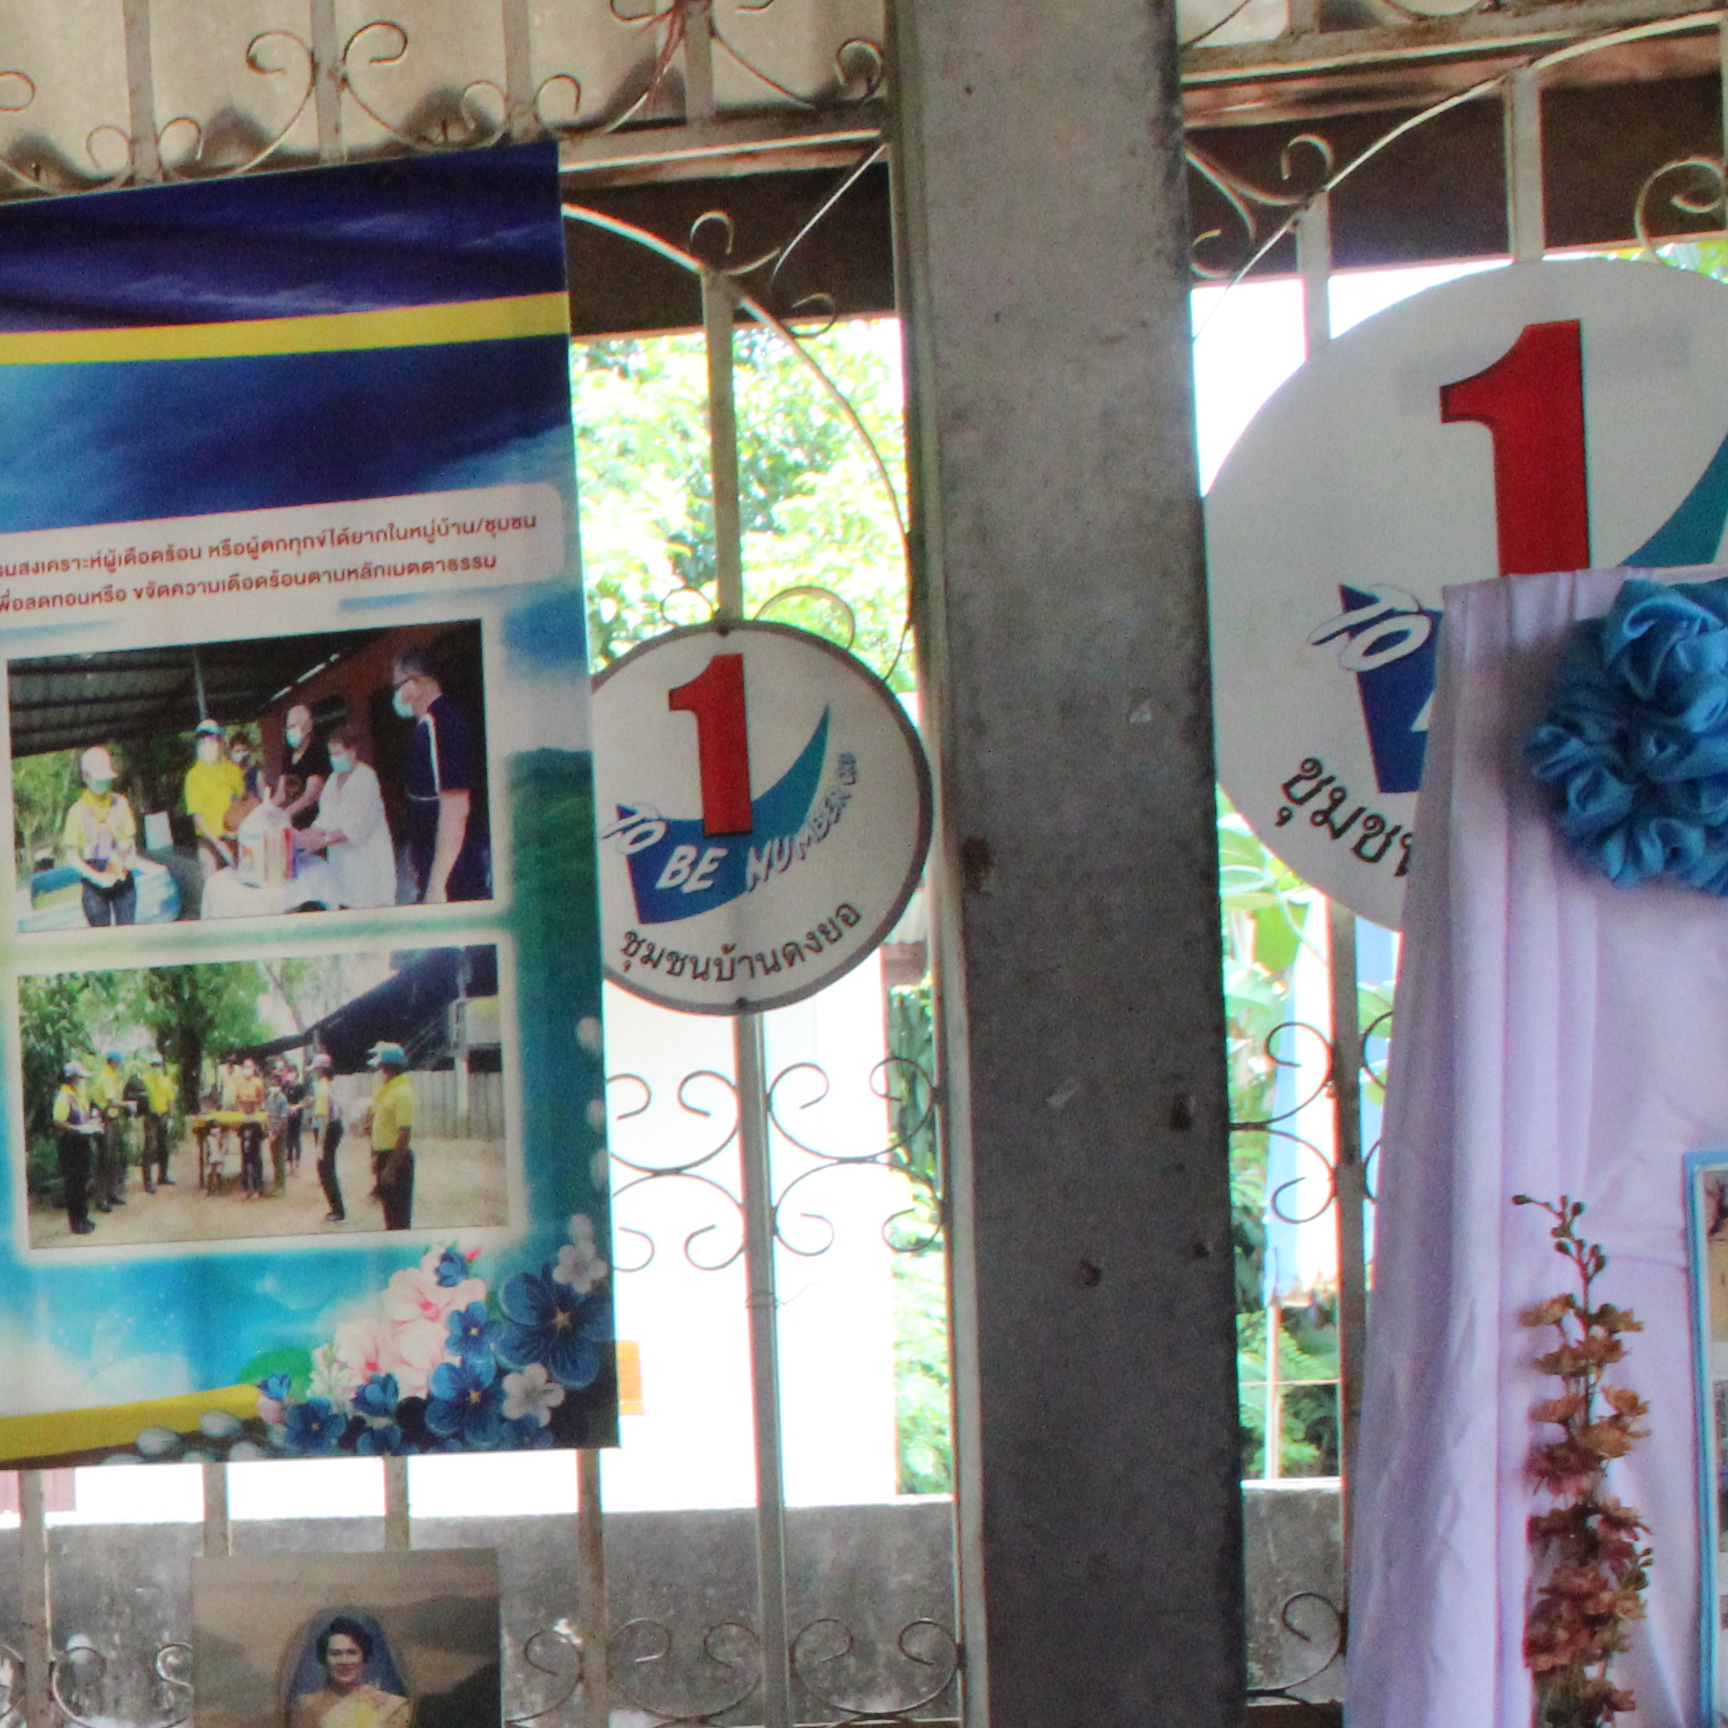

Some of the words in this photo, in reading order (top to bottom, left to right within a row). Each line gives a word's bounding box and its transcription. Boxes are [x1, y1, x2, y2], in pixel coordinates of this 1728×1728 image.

[1439, 318, 1591, 576] 1
[668, 653, 753, 839] 1
[655, 845, 728, 898] BE
[746, 788, 852, 893] NUMBER
